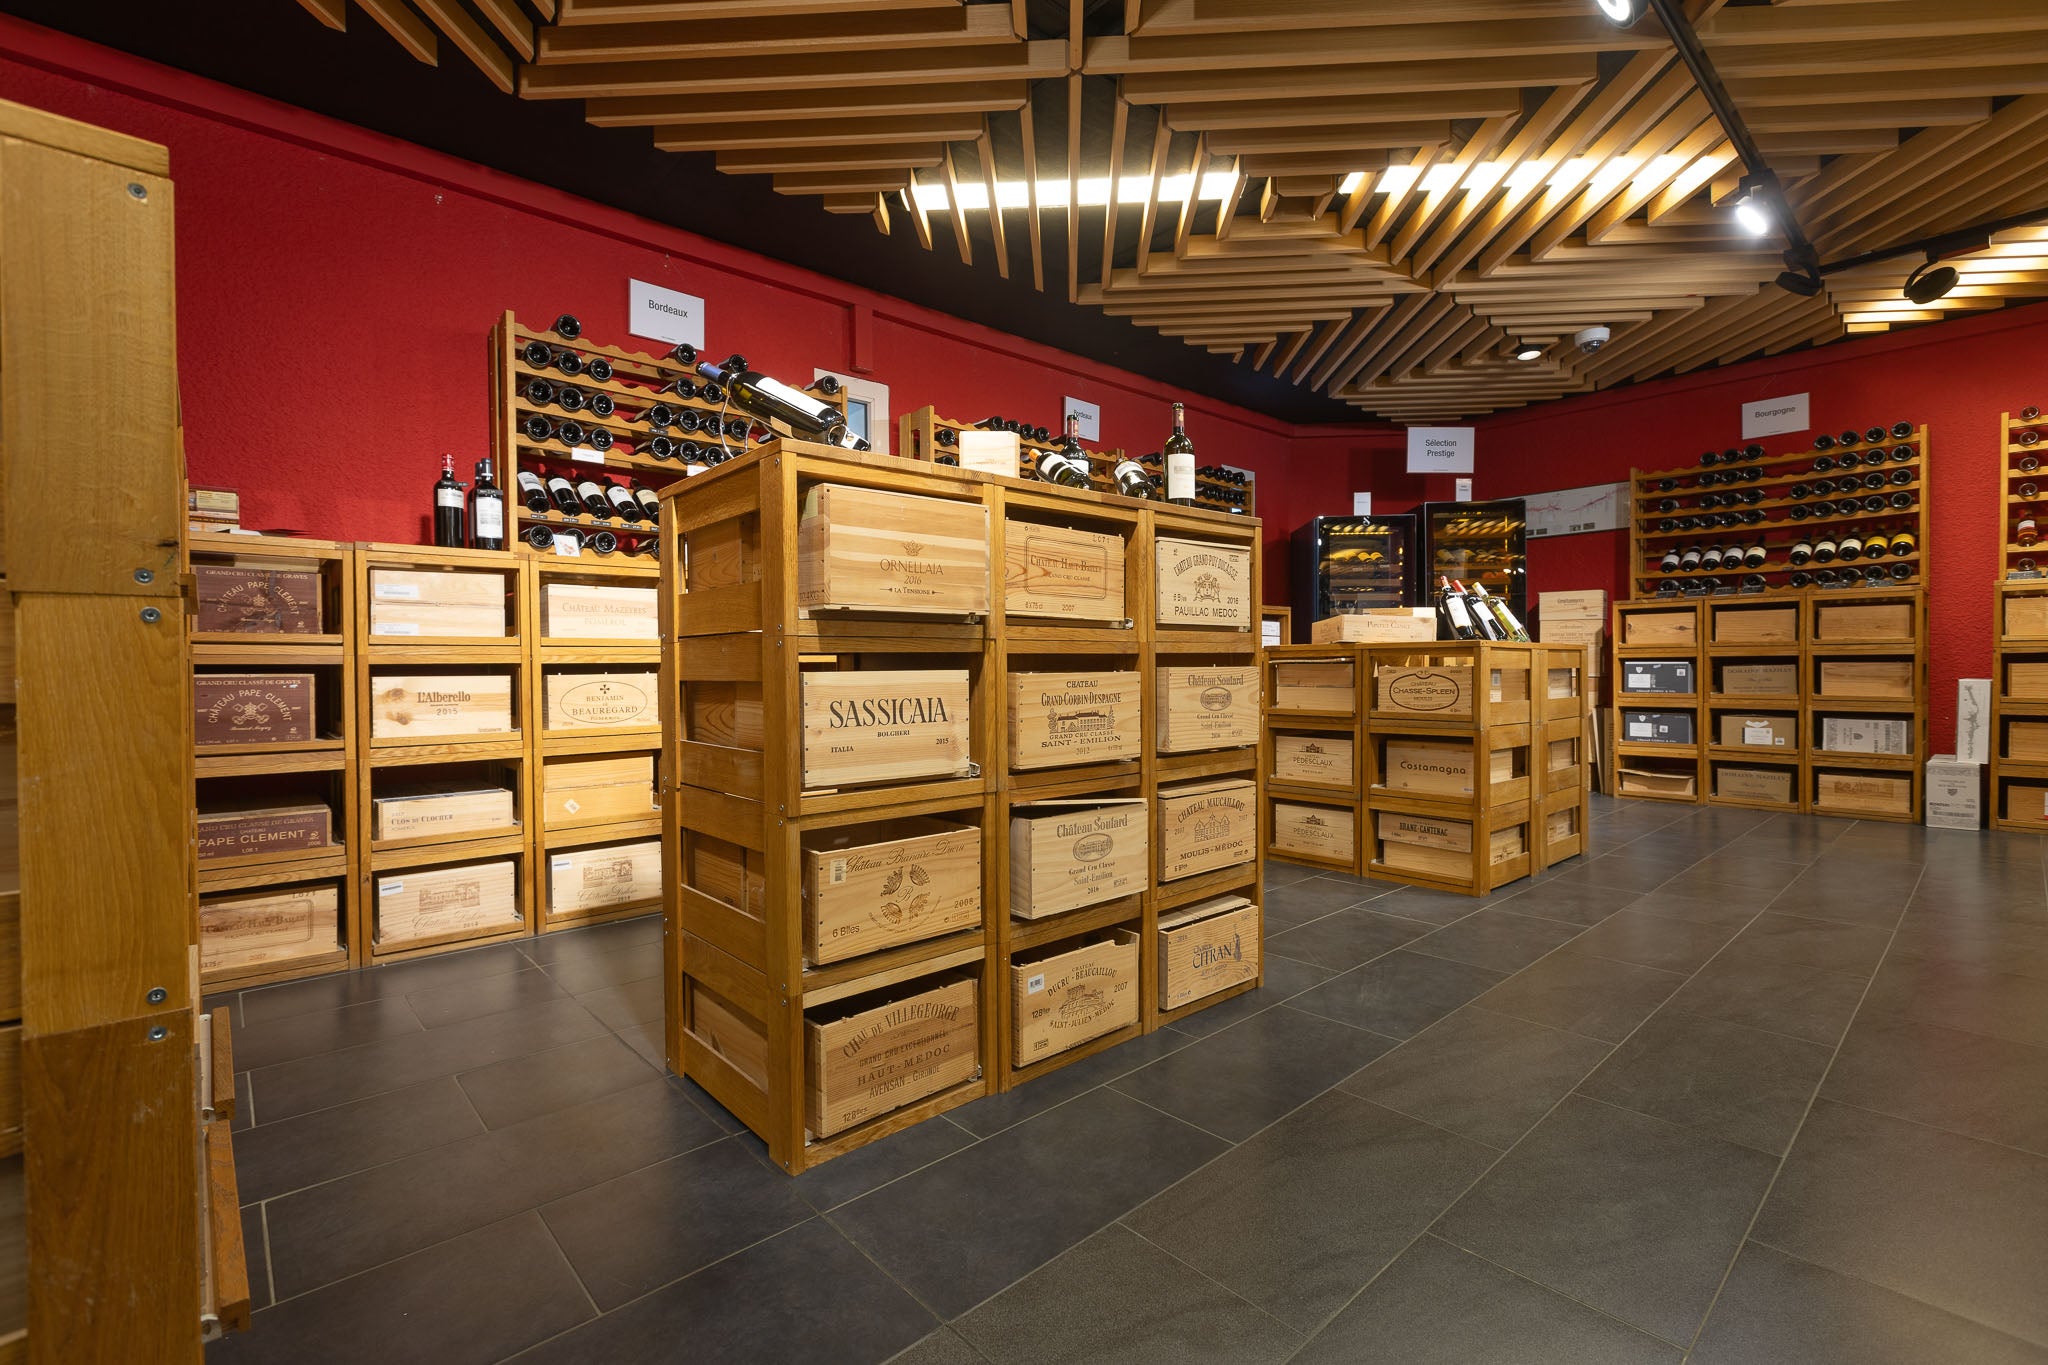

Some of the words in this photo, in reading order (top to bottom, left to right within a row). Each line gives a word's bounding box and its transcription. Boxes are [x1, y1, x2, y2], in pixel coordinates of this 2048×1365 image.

[648, 299, 688, 318] Bordeaux
[1755, 406, 1796, 419] Bourgogne
[1425, 439, 1457, 448] Sélection
[1427, 449, 1455, 459] Prestige
[880, 558, 944, 576] ORNELLAIA
[903, 575, 922, 585] 2016
[217, 584, 244, 613] CHATEAU
[247, 581, 270, 590] PAPE
[274, 586, 300, 615] CLEMENT
[1174, 606, 1209, 617] PAUILLAC
[1212, 607, 1238, 618] MEDOC
[1066, 680, 1098, 688] CHATEAU
[1392, 686, 1456, 695] CHASSE-SPLEEN
[208, 694, 235, 723] CHATEAU
[239, 689, 262, 697] PAPE
[265, 692, 292, 721] CLEMENT
[436, 707, 458, 716] 2015
[572, 705, 638, 716] BEAUREGARD
[830, 697, 948, 729] SASSICAIA
[877, 730, 910, 738] BOLGHERI
[1041, 739, 1072, 748] SAINT
[1080, 735, 1121, 745] EMILION
[1400, 761, 1466, 775] Costamagna
[1177, 799, 1205, 824] CHATEAU
[1206, 796, 1245, 812] MAUCAILLOU
[391, 818, 410, 826] CLOS
[421, 813, 453, 824] CLOCHER
[1056, 821, 1093, 840] Château
[1094, 814, 1129, 832] Soutard
[199, 836, 235, 848] PAPE
[240, 829, 305, 844] CLEMENT
[1068, 865, 1086, 876] Grand
[1087, 863, 1098, 872] Cru
[1192, 943, 1232, 969] CITRAN
[1072, 961, 1095, 972] CHATEAU
[1113, 981, 1128, 993] 2007
[871, 1023, 884, 1039] DE
[885, 1002, 960, 1028] VILLEGEORGE
[860, 1053, 882, 1068] GRAND
[884, 1047, 898, 1060] CRU
[900, 1030, 948, 1053] EXCEPTIONNEL
[869, 1075, 906, 1099] AVENSAN
[912, 1064, 941, 1082] GIRONDE
